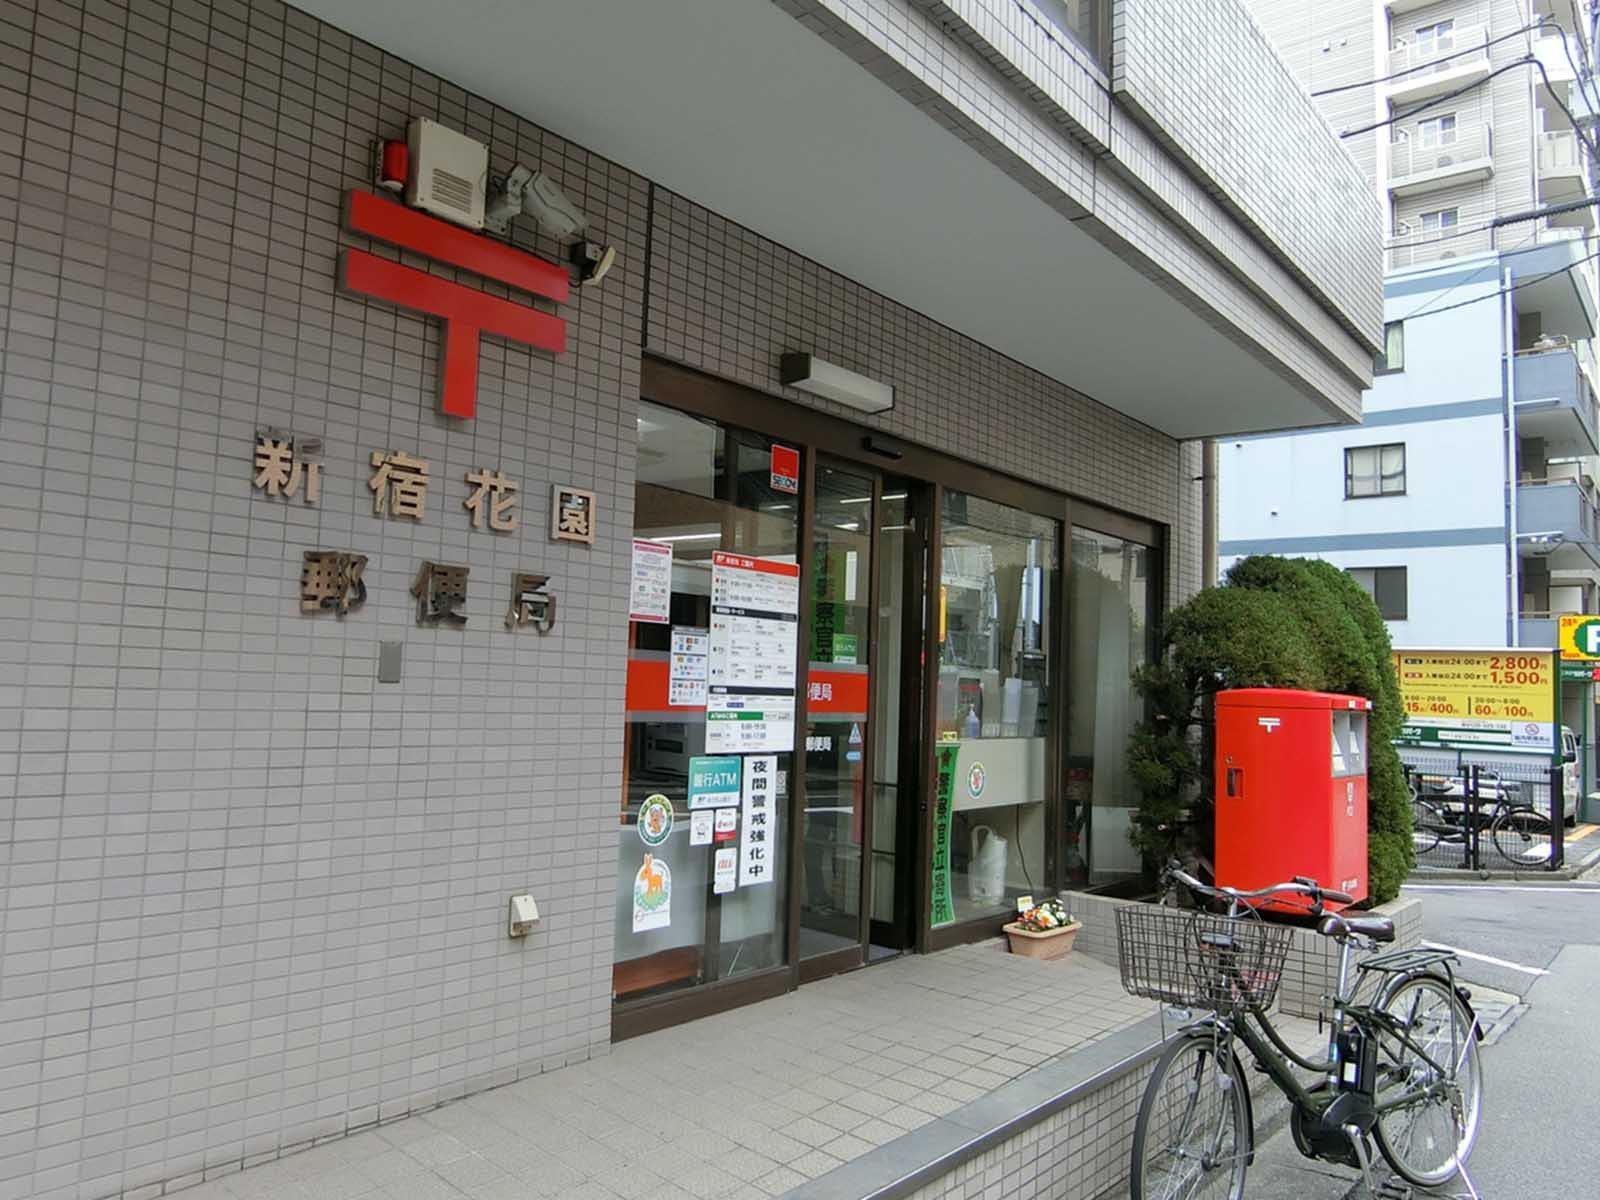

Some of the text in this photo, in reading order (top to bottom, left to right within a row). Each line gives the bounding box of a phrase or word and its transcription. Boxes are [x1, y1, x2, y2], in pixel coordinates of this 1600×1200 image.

[252, 426, 596, 544] 新宿花園
[301, 551, 556, 636] 郵便局
[808, 683, 832, 701] 便局
